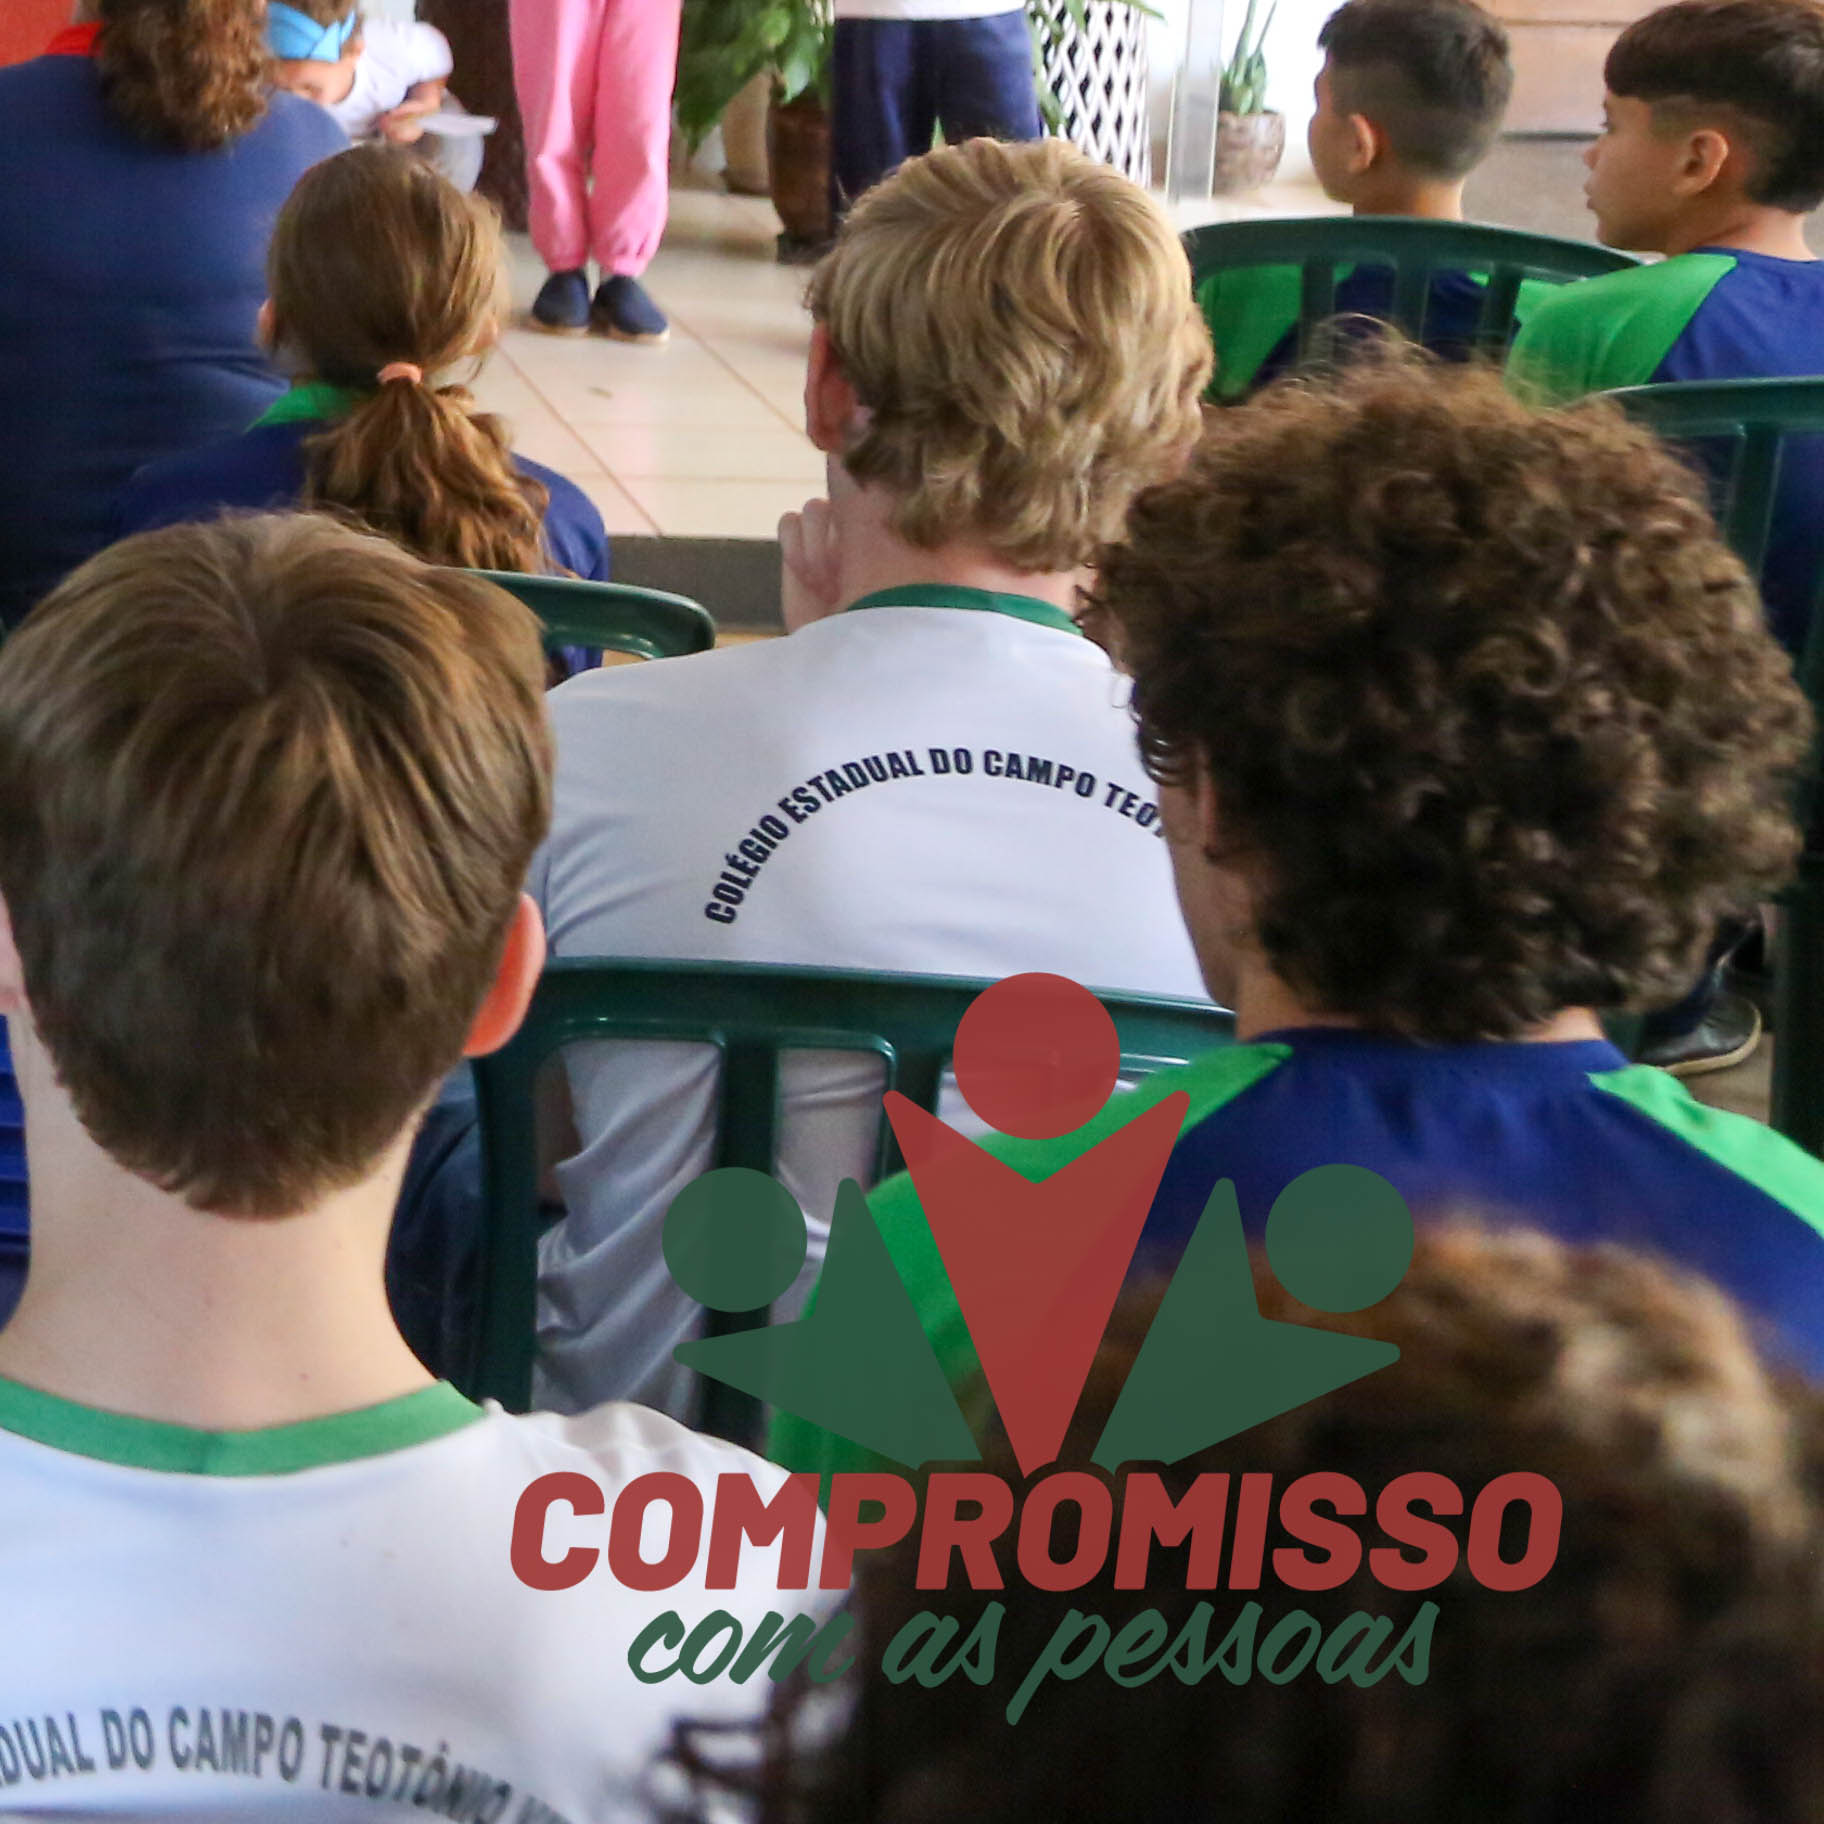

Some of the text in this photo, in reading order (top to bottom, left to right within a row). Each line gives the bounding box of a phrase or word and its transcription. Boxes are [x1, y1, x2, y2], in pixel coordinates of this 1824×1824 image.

[704, 812, 792, 926] COLÉGIO
[778, 749, 926, 825] ESTADUAL
[928, 746, 975, 776] DO
[983, 748, 1098, 799] CAMPO
[101, 1705, 155, 1771] DO
[167, 1705, 306, 1784] CAMPO
